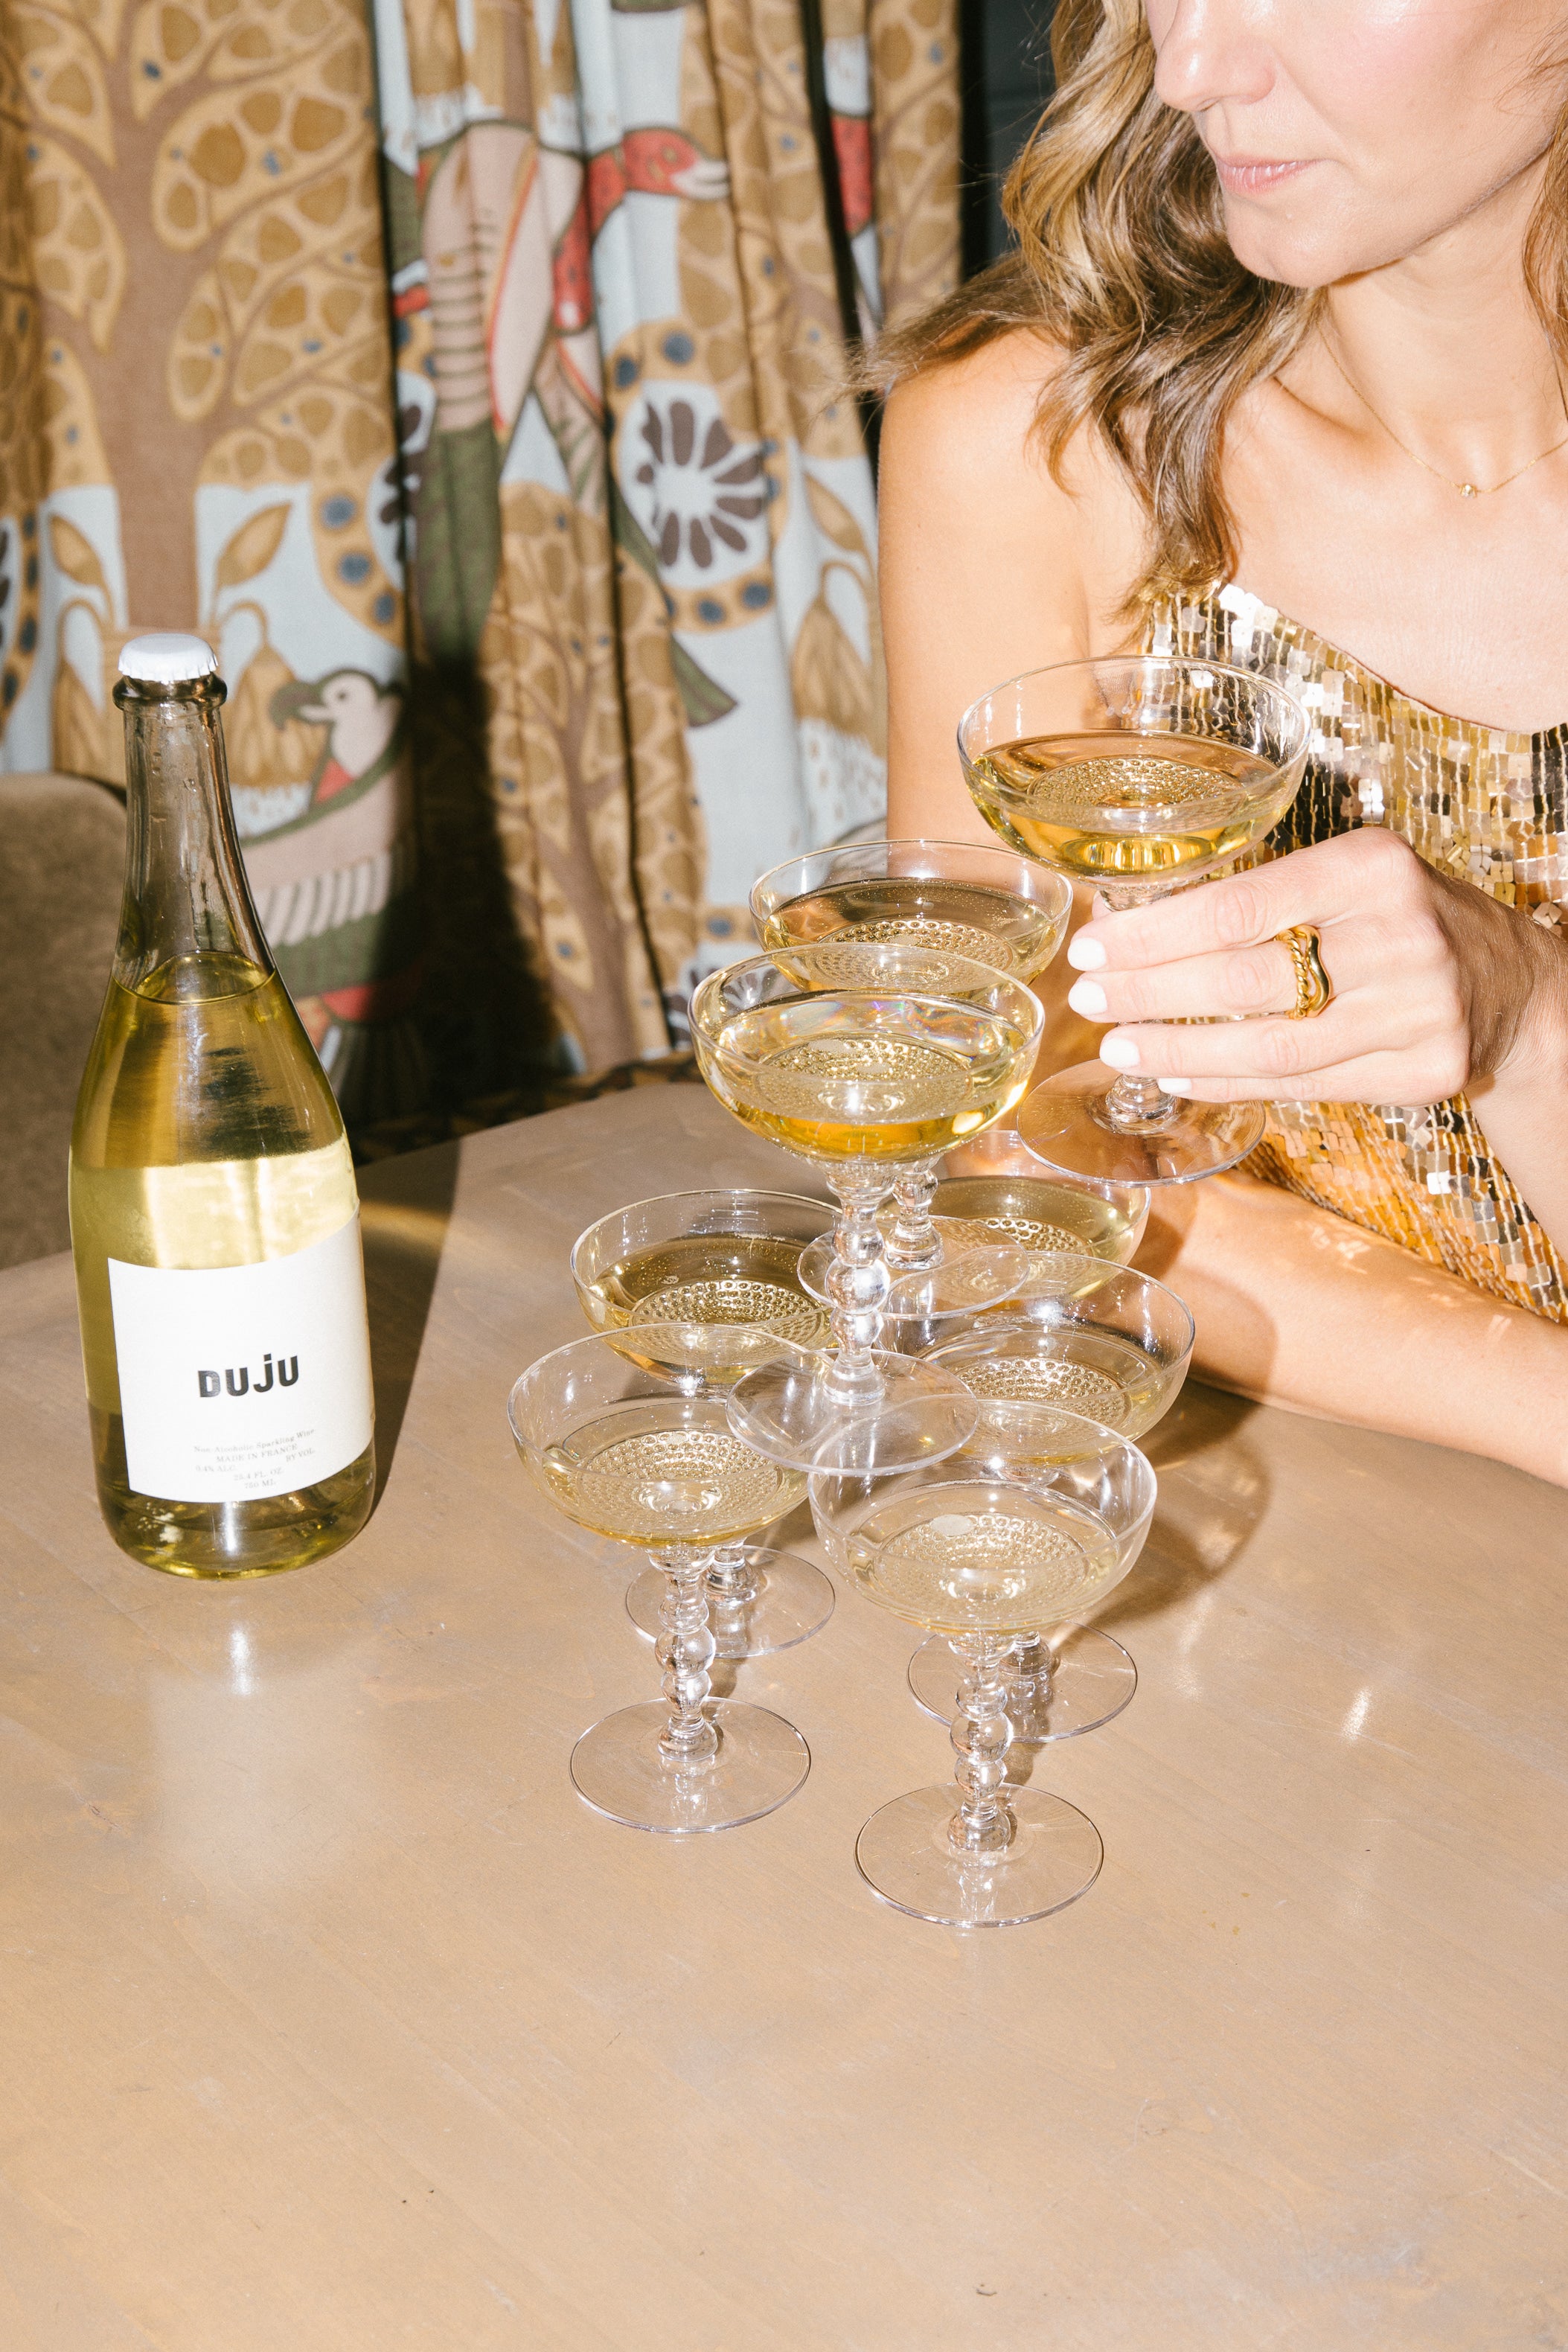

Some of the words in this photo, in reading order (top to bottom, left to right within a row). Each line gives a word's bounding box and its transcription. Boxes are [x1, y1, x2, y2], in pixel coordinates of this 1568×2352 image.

[256, 1436, 295, 1449] Sparkling
[296, 1428, 315, 1439] Wine
[216, 1454, 244, 1463] MADE
[248, 1452, 258, 1460] IN
[261, 1443, 298, 1458] FRANCE
